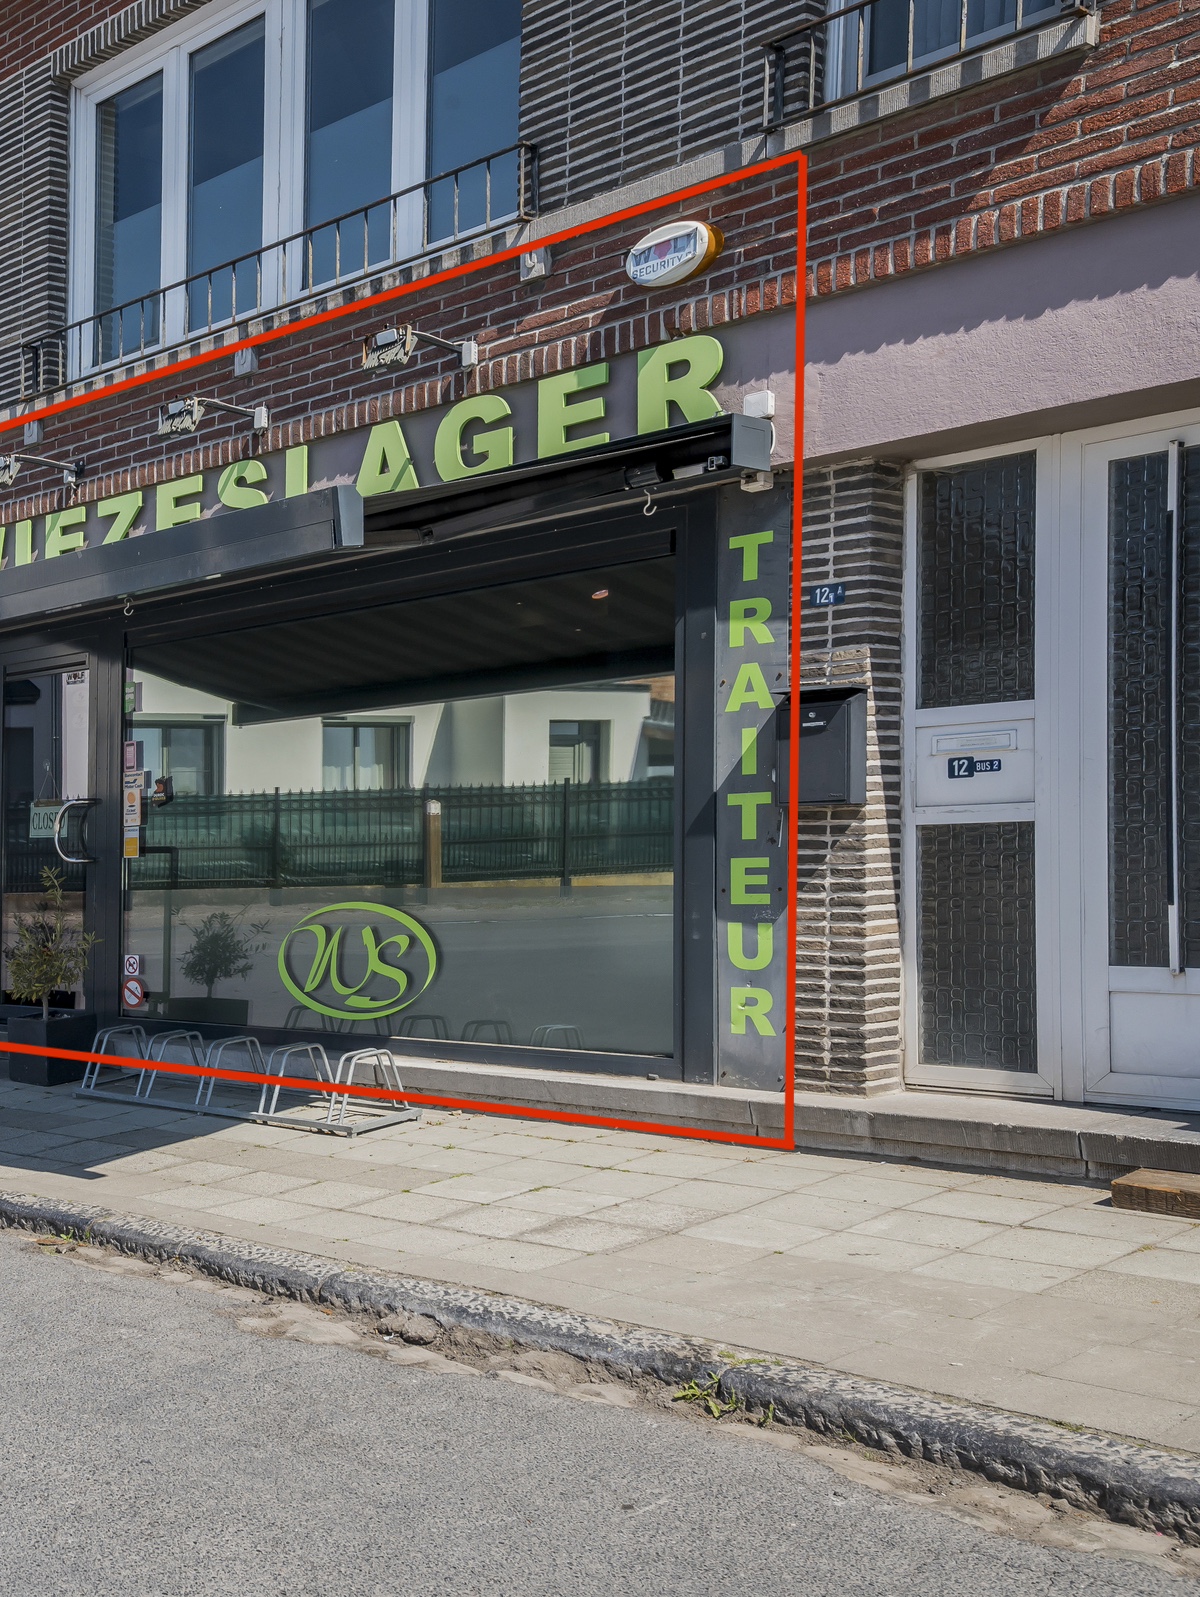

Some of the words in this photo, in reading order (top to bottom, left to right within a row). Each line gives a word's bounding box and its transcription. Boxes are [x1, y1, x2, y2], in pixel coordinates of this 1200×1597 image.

[632, 254, 683, 279] SECURITY
[815, 587, 829, 603] 12
[952, 759, 968, 776] 12
[976, 762, 990, 771] BUS
[993, 760, 998, 769] 2
[724, 530, 777, 1037] TRAITEUR
[32, 812, 66, 830] CLOS
